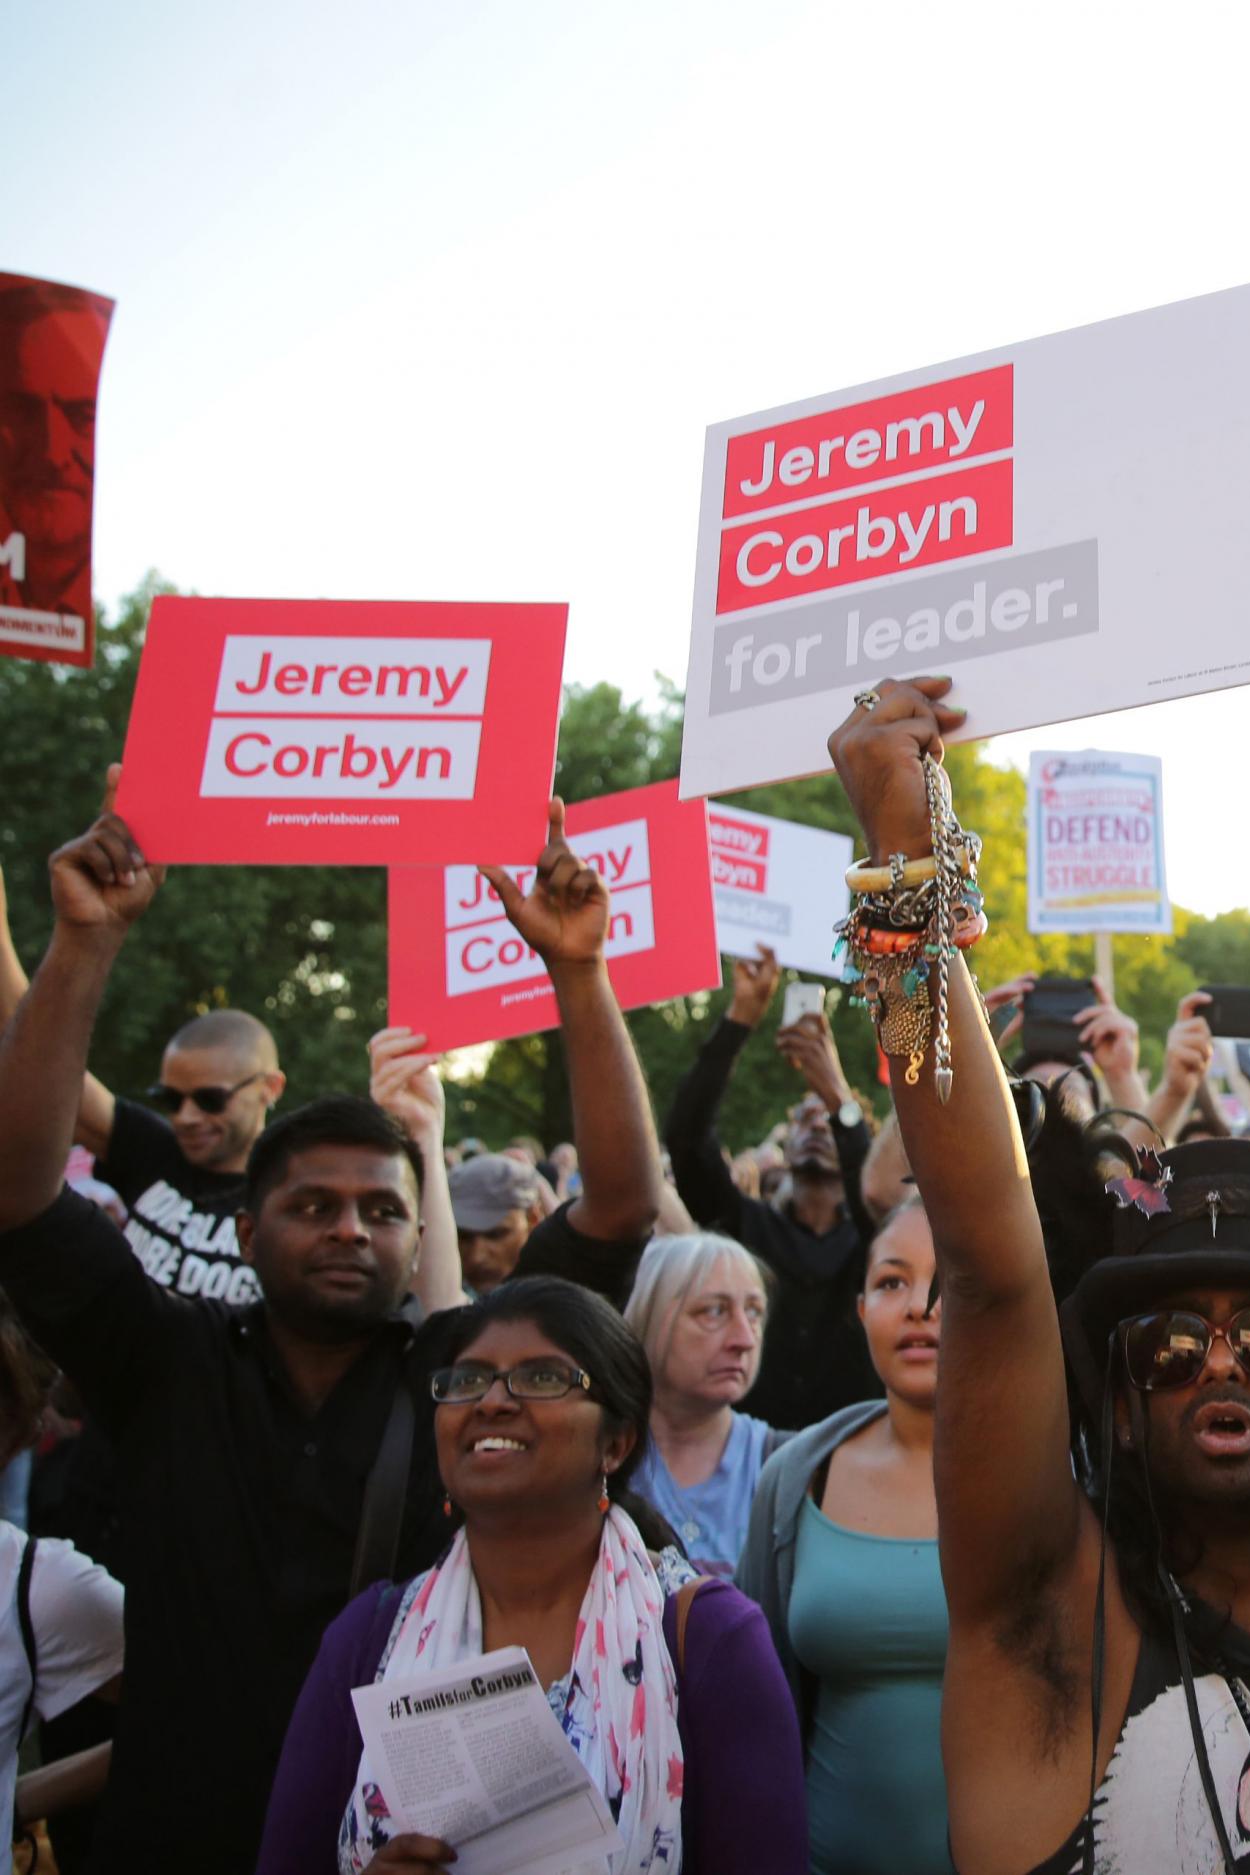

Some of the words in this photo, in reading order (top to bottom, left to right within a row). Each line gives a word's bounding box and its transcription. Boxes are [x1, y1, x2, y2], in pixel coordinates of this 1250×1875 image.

[739, 400, 986, 498] Jeremy
[735, 495, 978, 588] Corbyn
[724, 632, 822, 694] for
[845, 574, 1078, 666] leader.
[235, 651, 469, 708] Jeremy
[223, 731, 454, 789] Corbyn
[267, 811, 400, 827] jeremyforlabour.com
[1046, 815, 1152, 845] DEFEND
[1045, 864, 1152, 890] STRUGGLE
[179, 1212, 242, 1258] BLA
